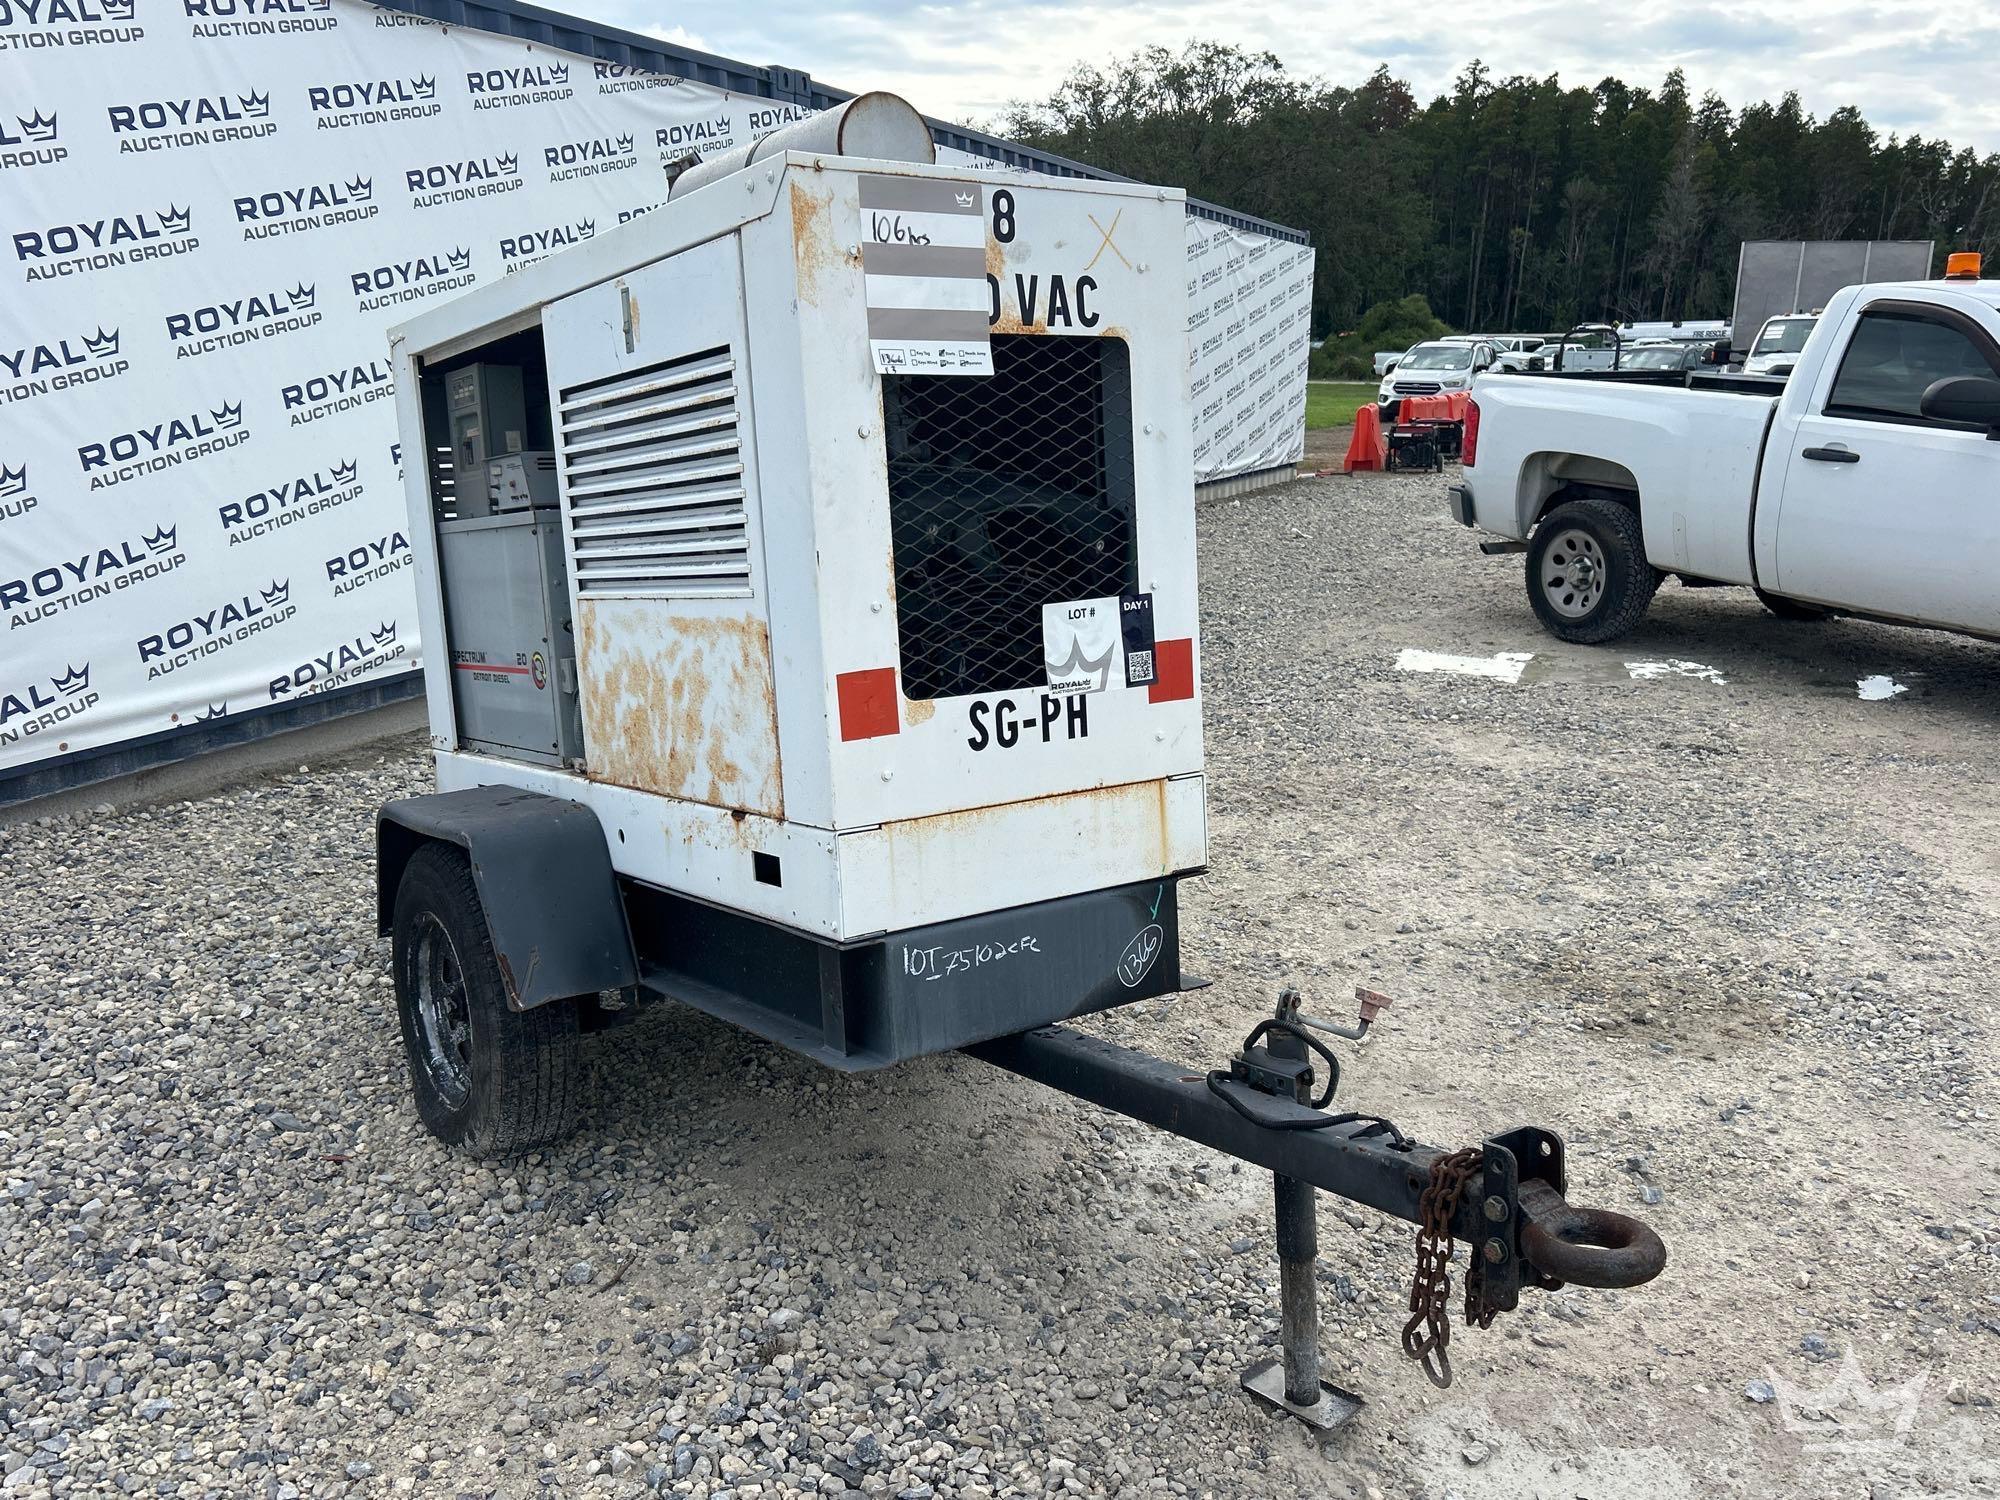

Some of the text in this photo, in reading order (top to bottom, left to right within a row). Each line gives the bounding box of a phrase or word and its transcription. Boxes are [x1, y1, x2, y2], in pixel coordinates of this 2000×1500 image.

[68, 27, 144, 45] GROUP
[192, 18, 337, 38] AUCTION GROUP
[308, 80, 413, 111] ROYAL
[467, 66, 550, 93] ROYAL
[599, 78, 684, 95] AUCTION GROUP
[107, 96, 242, 133] ROYAL
[317, 104, 441, 130] AUCTION GROUP
[474, 89, 573, 110] AUCTION GROUP
[749, 106, 802, 129] ROYAL
[120, 123, 277, 154] AUCTION GROUP
[655, 121, 717, 147] ROYAL
[702, 138, 733, 152] GROUP
[0, 147, 68, 169] ROUP
[544, 139, 617, 168] ROYAL
[550, 157, 637, 183] AUCTION GROUP
[406, 159, 497, 192] ROYAL
[233, 184, 348, 224] ROYAL
[413, 179, 523, 209] AUCTION GROUP
[244, 205, 378, 241] AUCTION GROUP
[992, 189, 1016, 243] 8
[12, 214, 161, 262] ROYAL
[500, 225, 579, 259] ROYAL
[26, 238, 199, 282] AUCTION GROUP
[352, 256, 451, 295] ROYAL
[359, 274, 475, 313] AUCTION GROUP
[1015, 273, 1100, 328] VAC
[166, 293, 289, 342] ROYAL
[177, 312, 322, 359] AUCTION GROUP
[1692, 329, 1728, 338] FIRE RESCUE
[51, 360, 129, 390] GROUP
[281, 362, 387, 409] ROYAL
[291, 384, 395, 427] AUCTION GRO
[77, 414, 214, 473] ROYAL
[91, 430, 250, 491] AUCTION GROUP
[219, 473, 333, 531] ROYAL
[230, 485, 363, 547] AUCTION GROUP
[326, 531, 410, 581] ROYA
[0, 541, 146, 611] ROYAL
[11, 553, 186, 630] AUCTION GROUP
[334, 559, 401, 597] AUCTION
[1068, 607, 1096, 620] LOT #
[1123, 600, 1149, 611] DAY 1
[137, 596, 263, 663] ROYAL
[148, 605, 296, 681] AUCTION GROUP
[269, 638, 375, 700] ROYAL
[350, 645, 405, 678] GROUP
[516, 652, 528, 666] 20
[1051, 680, 1082, 691] ROYAL
[23, 692, 99, 736] GROUP
[967, 694, 1089, 752] SG-PH
